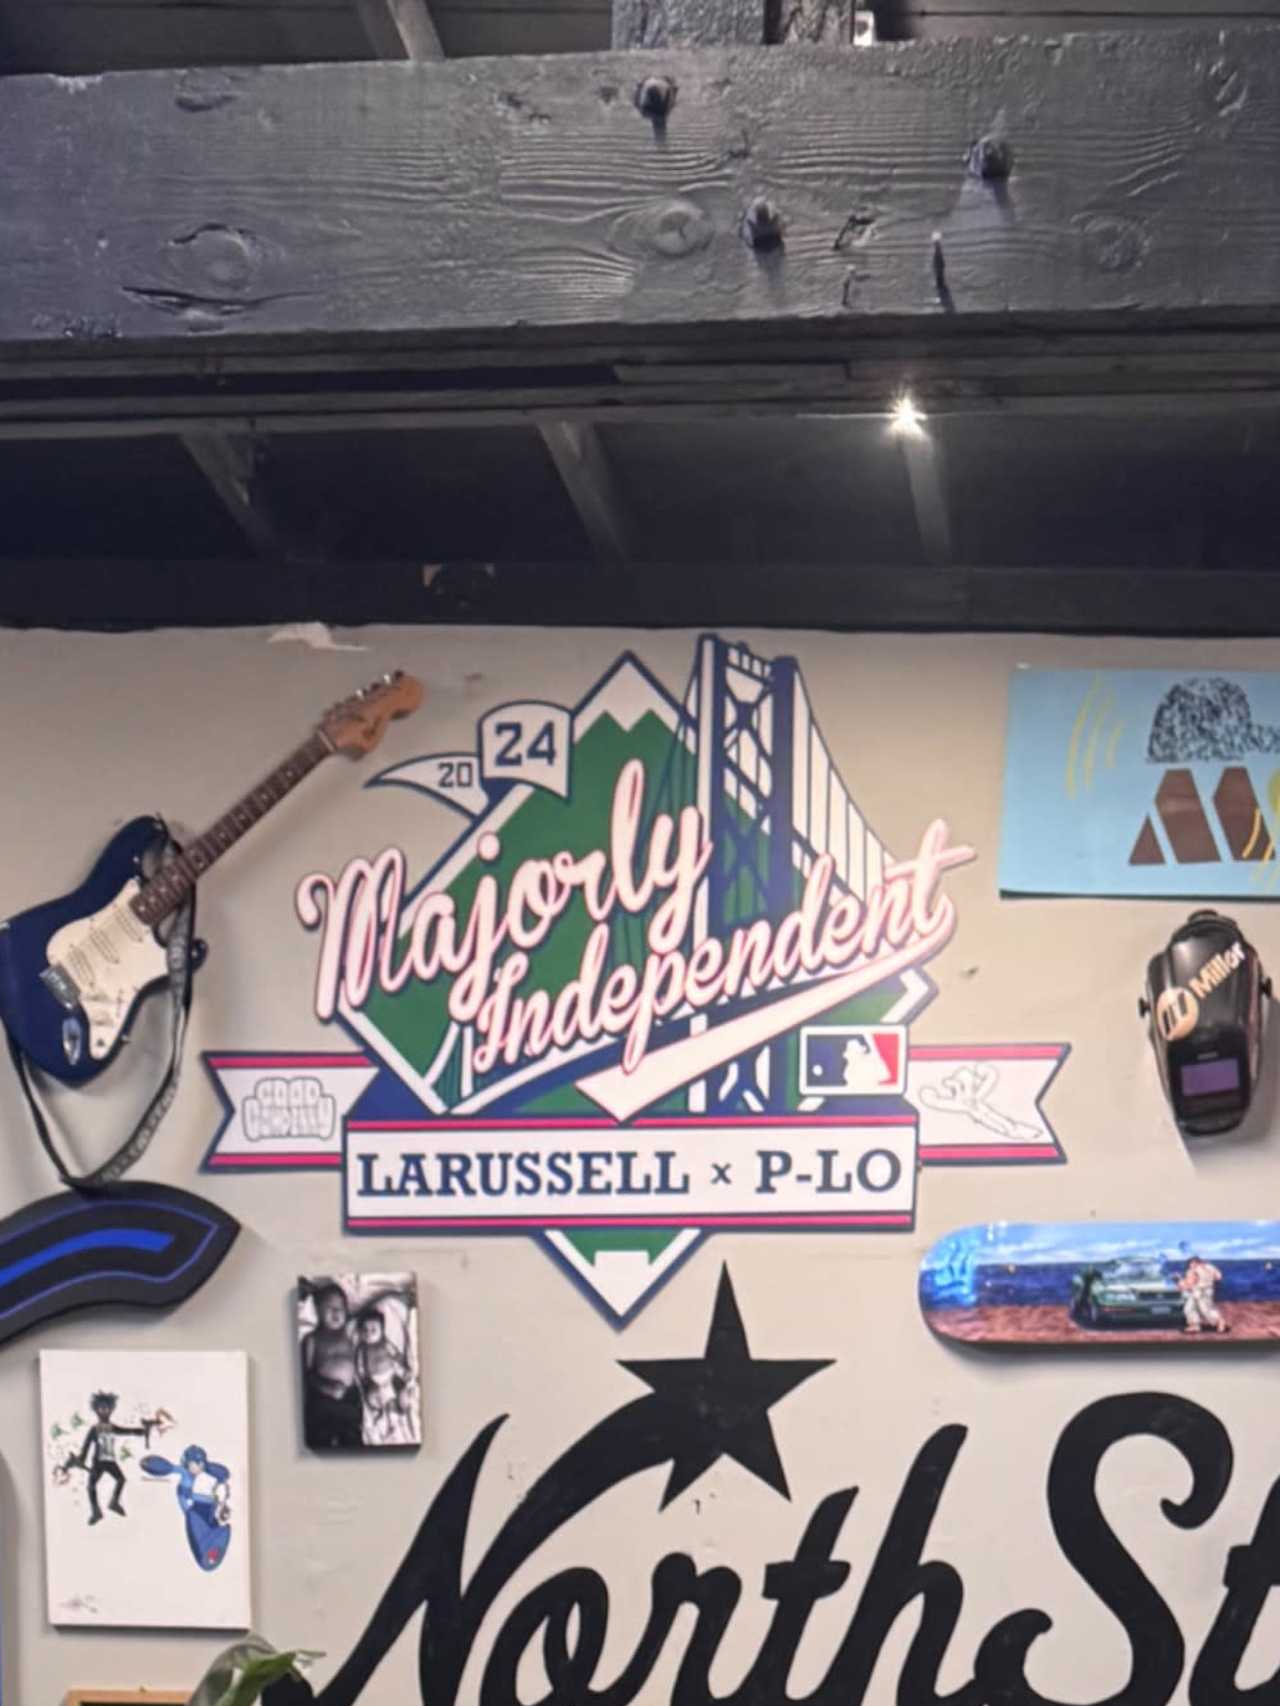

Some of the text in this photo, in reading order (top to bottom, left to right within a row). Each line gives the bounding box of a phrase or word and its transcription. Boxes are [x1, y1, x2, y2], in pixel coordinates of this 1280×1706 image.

[438, 722, 557, 790] 20 24
[297, 757, 717, 1024] Majorly
[472, 818, 976, 1076] Independent
[356, 1149, 691, 1199] LARUSSELL
[754, 1146, 903, 1196] P-LO
